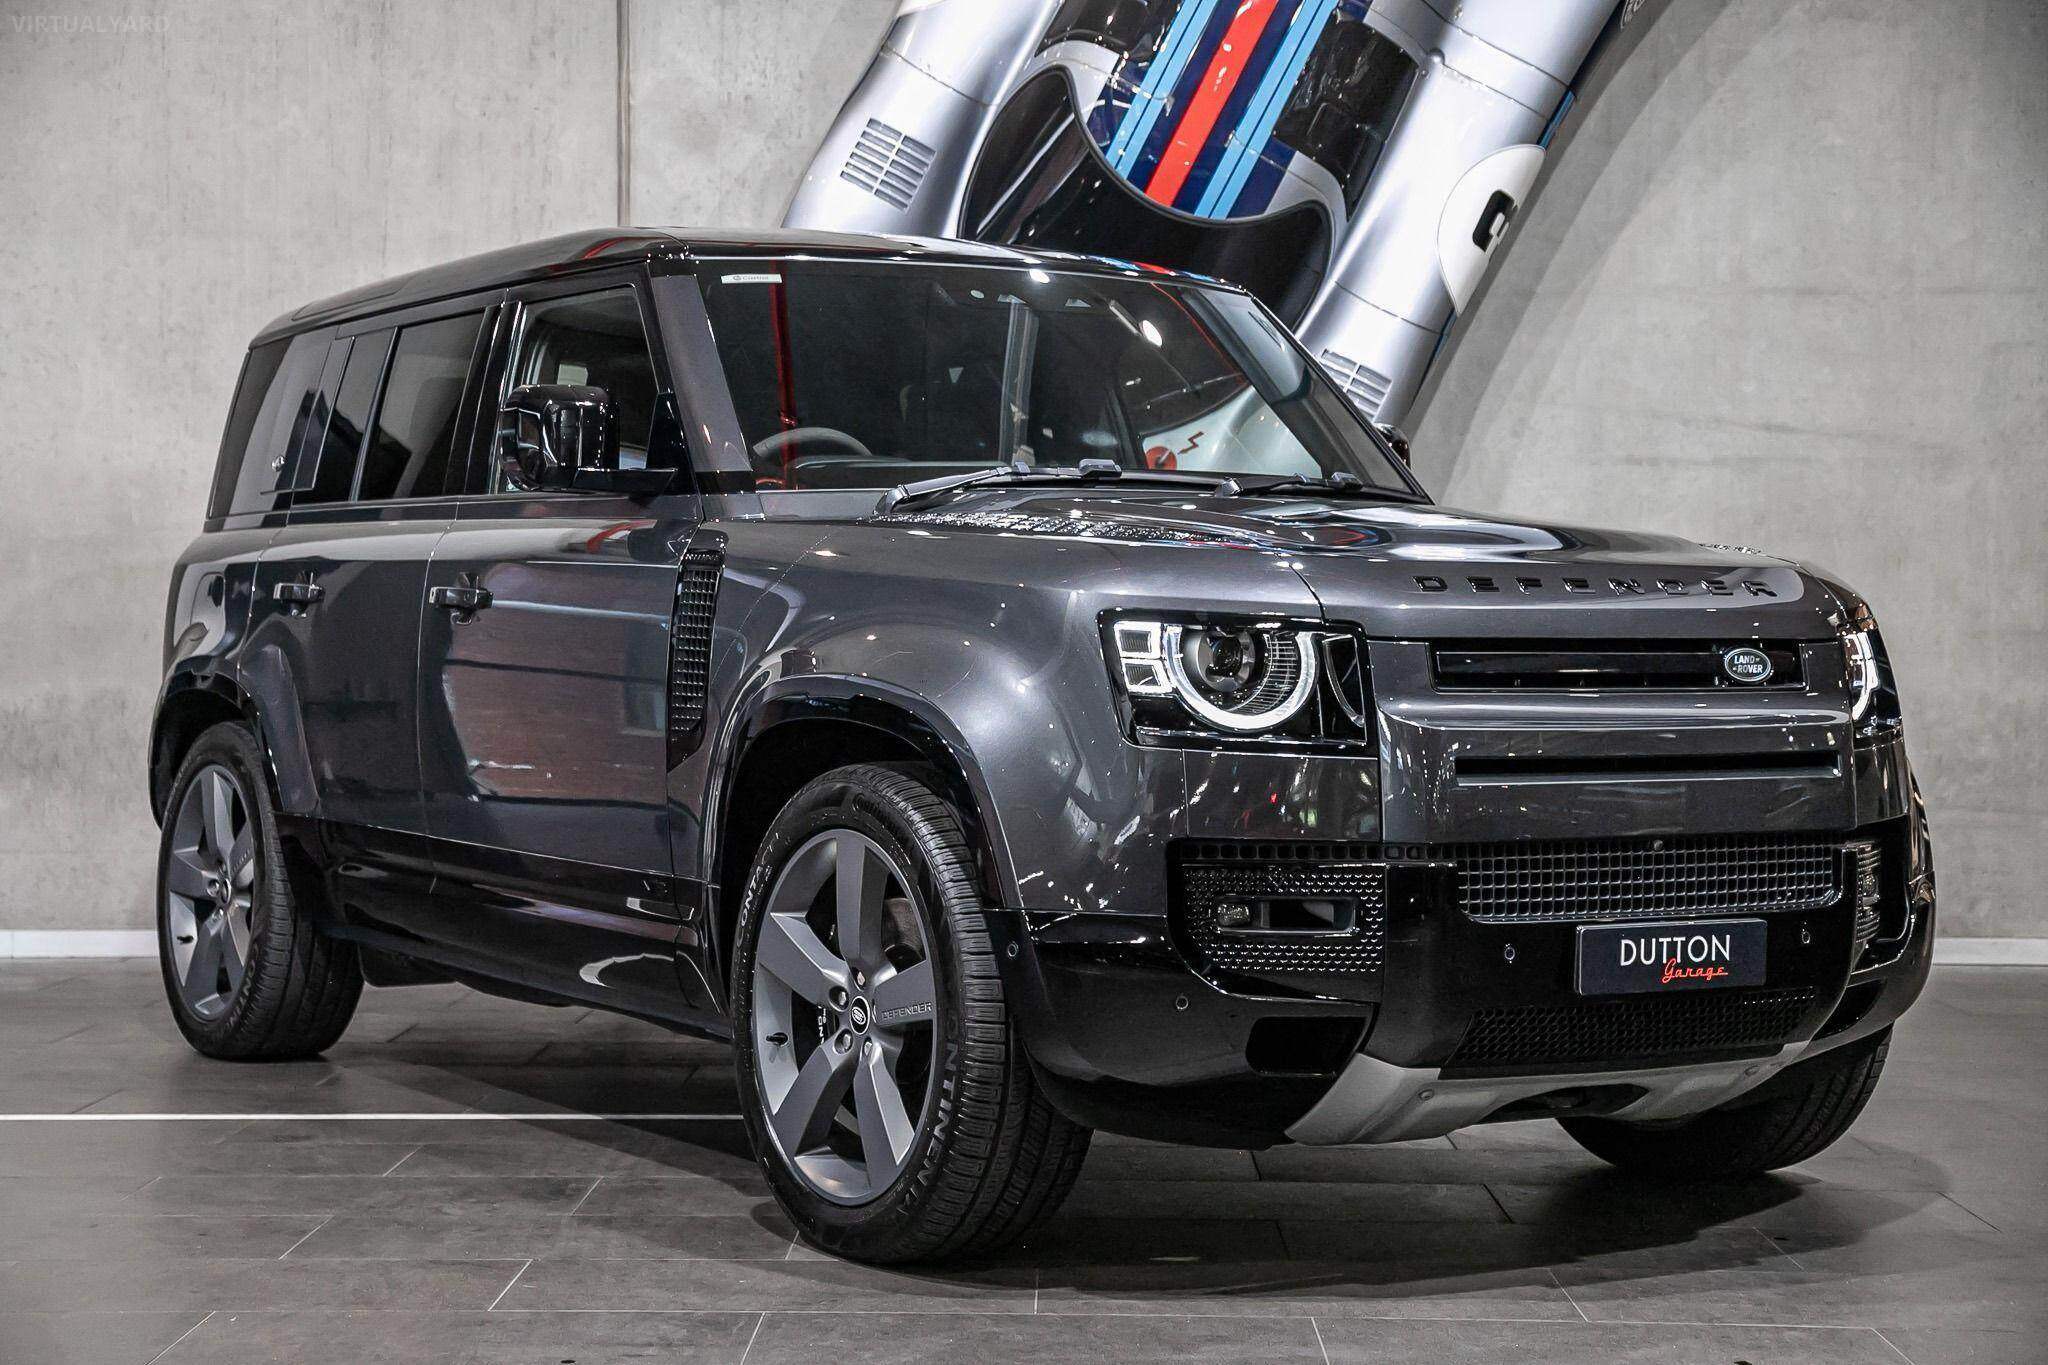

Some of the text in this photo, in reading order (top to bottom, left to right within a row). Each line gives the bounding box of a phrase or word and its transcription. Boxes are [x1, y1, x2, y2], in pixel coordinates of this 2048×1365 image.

[1411, 575, 1778, 598] DEFENDER
[1734, 655, 1755, 664] LAND
[1737, 664, 1763, 674] ROVER
[1620, 934, 1731, 966] DUTTON
[1661, 958, 1729, 984] Garage
[880, 1001, 933, 1019] DEFENDER
